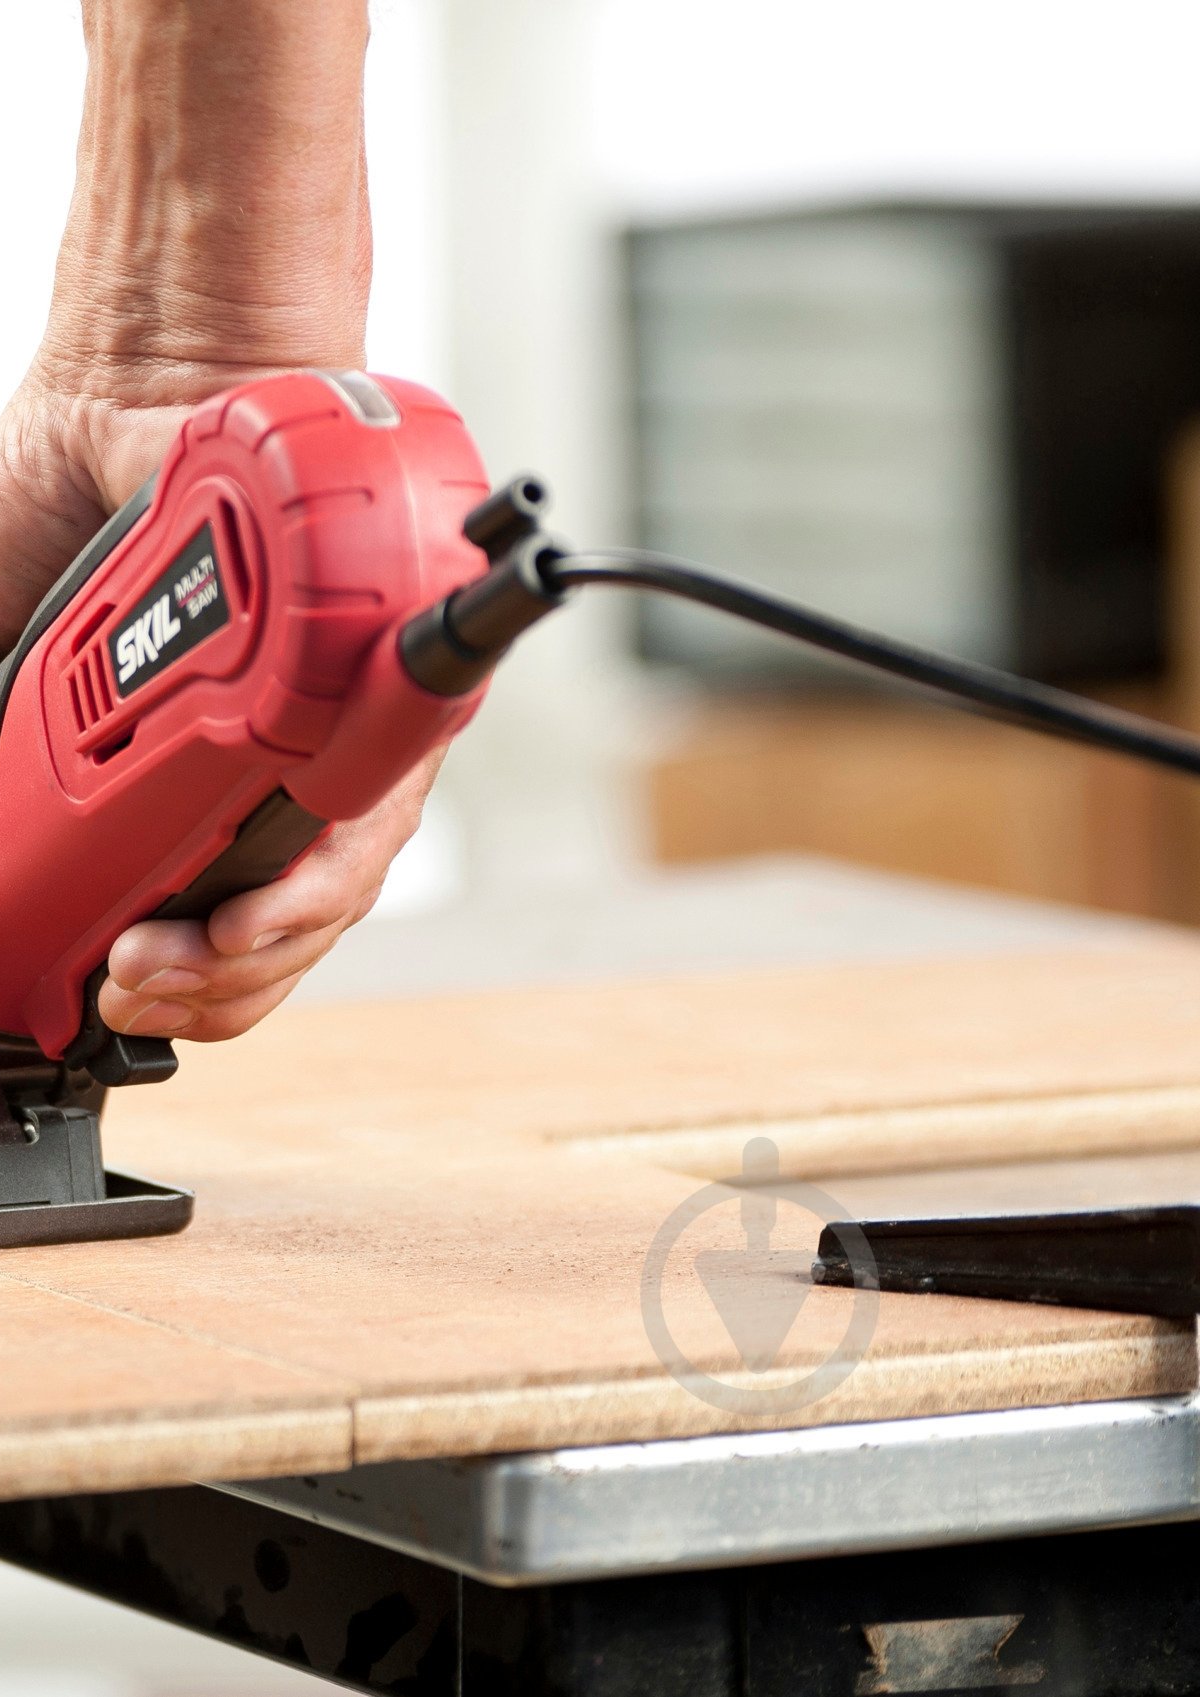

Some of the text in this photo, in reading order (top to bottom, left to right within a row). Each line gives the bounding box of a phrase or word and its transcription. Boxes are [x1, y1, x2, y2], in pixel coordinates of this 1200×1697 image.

[174, 554, 214, 601] MULTI
[186, 579, 218, 619] SAW
[116, 593, 181, 684] SKIL
